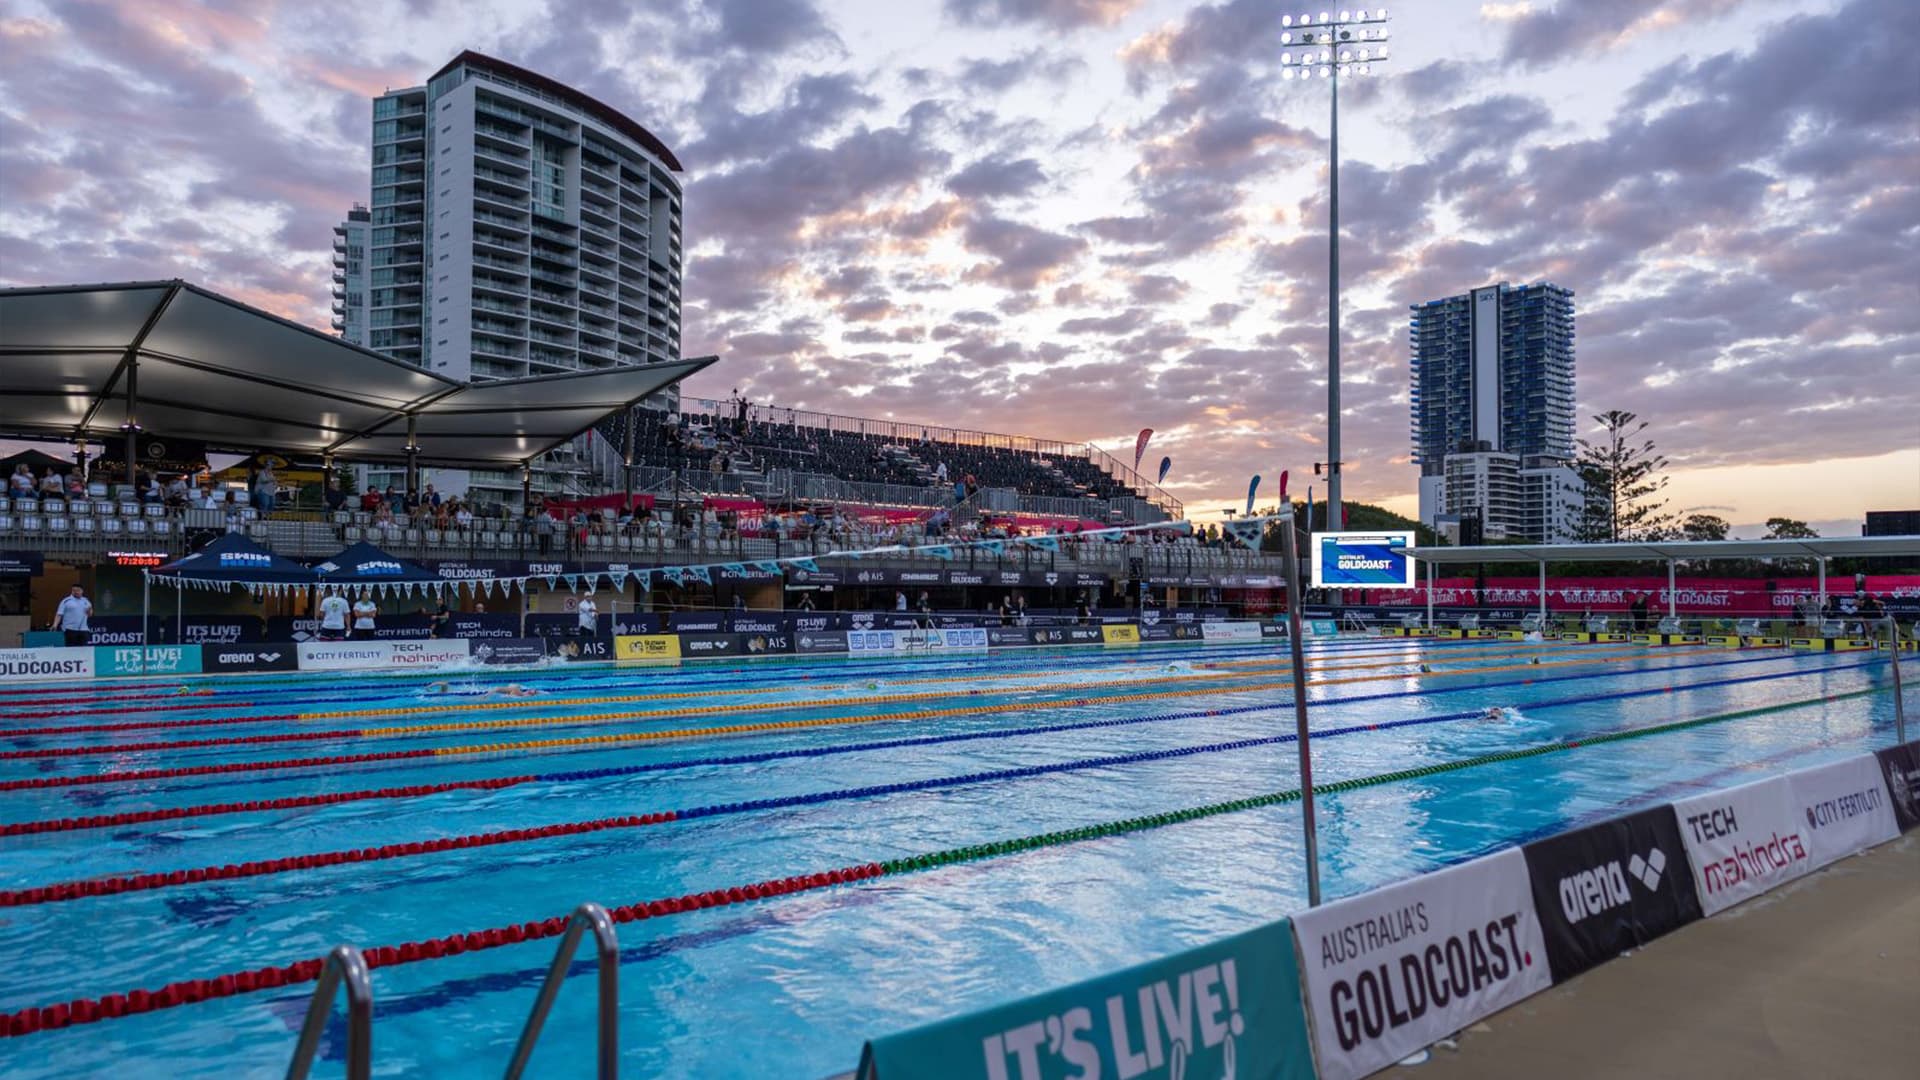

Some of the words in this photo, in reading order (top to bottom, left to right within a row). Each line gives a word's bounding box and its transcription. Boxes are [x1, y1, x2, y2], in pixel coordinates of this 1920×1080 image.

[220, 553, 271, 561] SWIM
[357, 561, 402, 570] SWIM
[529, 564, 542, 572] IT'S
[543, 564, 563, 572] LIVE!
[1338, 560, 1392, 570] GOLDCOAST.
[438, 568, 496, 578] GOLDCOAST.
[871, 572, 885, 580] AIS
[186, 624, 208, 636] IT'S
[210, 624, 241, 636] LIVE!
[377, 629, 395, 637] CITY
[396, 628, 433, 636] FERTILITY
[456, 629, 513, 638] mahindra
[630, 624, 648, 633] AIS
[392, 643, 423, 651] TECH
[769, 637, 787, 648] AIS
[583, 642, 606, 654] AIS
[0, 653, 37, 661] TRALIA'S
[115, 648, 141, 662] IT'S
[145, 647, 182, 661] LIVE!
[218, 652, 255, 664] arena
[316, 652, 336, 660] CITY
[338, 651, 381, 660] FERTILITY
[1815, 799, 1839, 827] CITY
[1838, 786, 1882, 820] FERTILITY
[1687, 805, 1738, 843] TECH
[1703, 832, 1807, 894] mahindra
[1559, 860, 1632, 924] arena
[1321, 901, 1429, 968] AUSTRALIA'S
[1330, 913, 1532, 1052] GOLDCOAST.
[1106, 959, 1245, 1080] LIVE!
